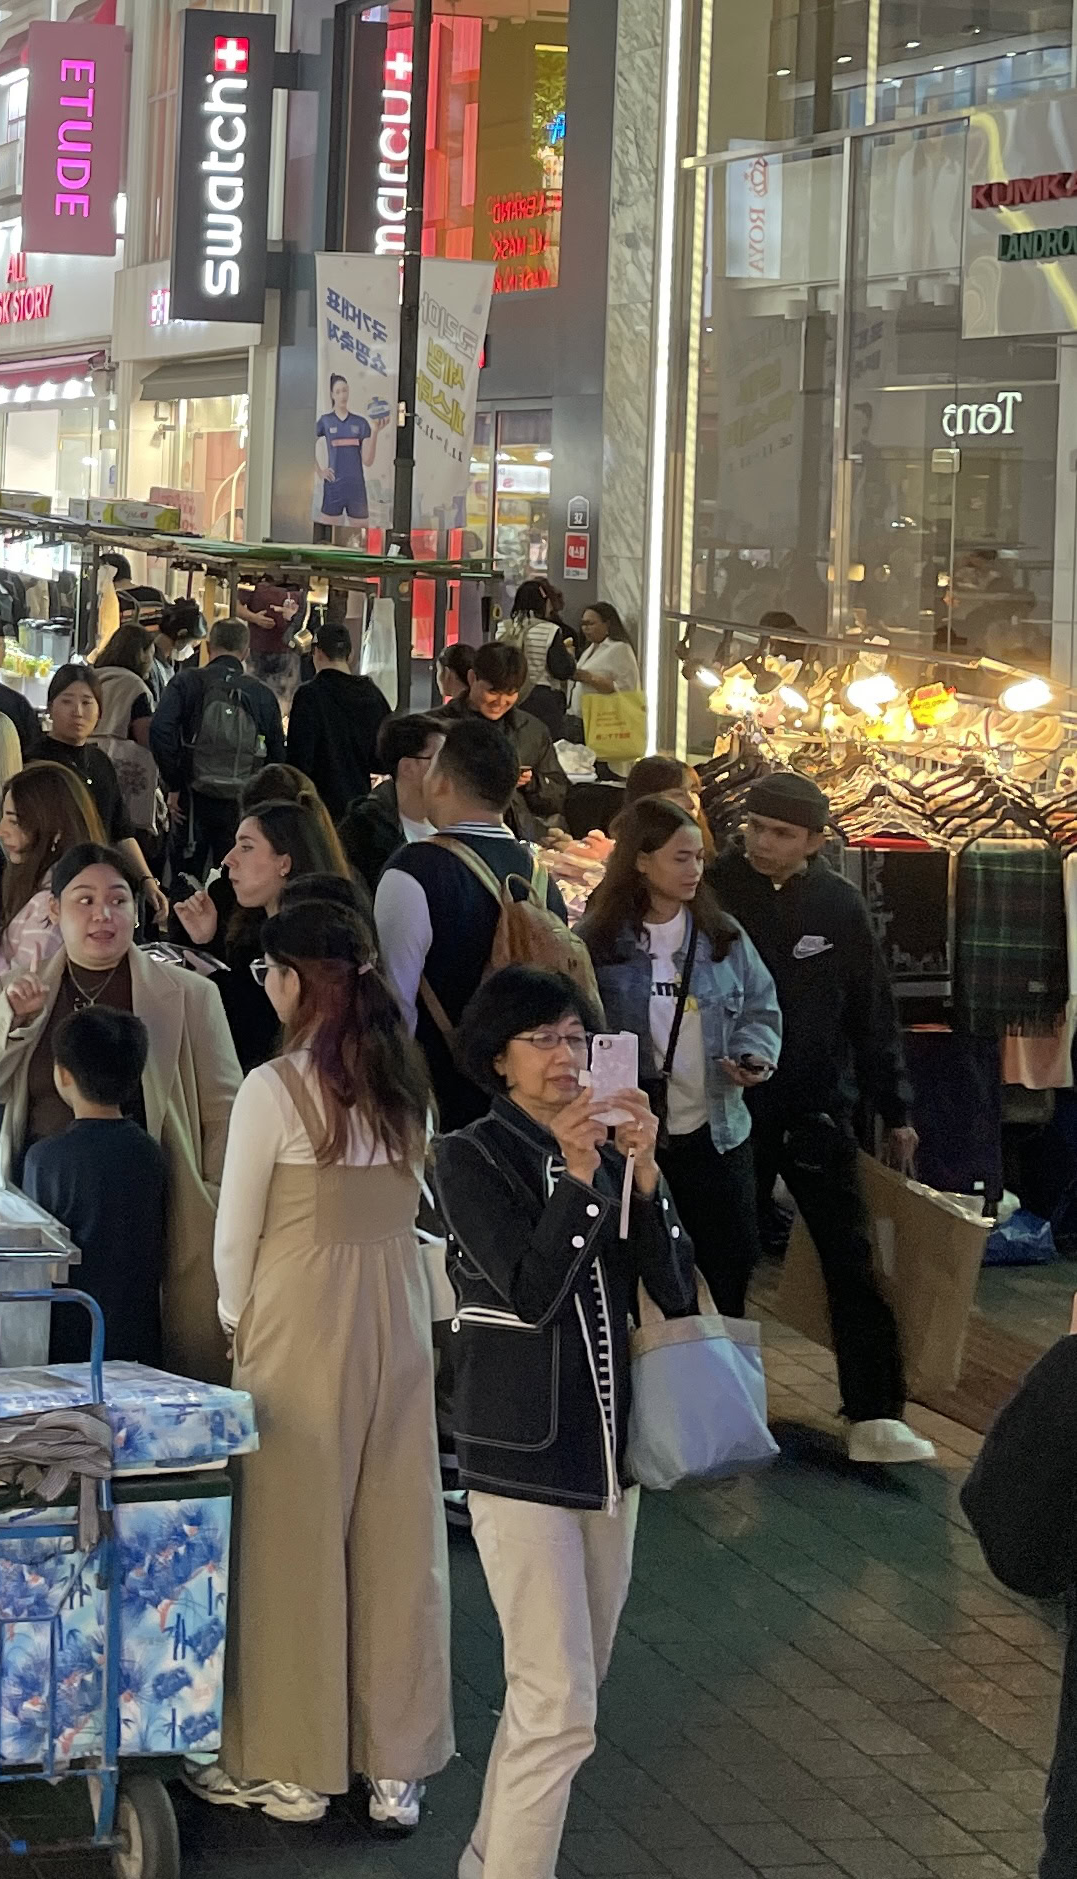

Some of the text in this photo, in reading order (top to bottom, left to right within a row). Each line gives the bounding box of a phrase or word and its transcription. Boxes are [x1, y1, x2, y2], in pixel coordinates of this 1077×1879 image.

[55, 58, 96, 218] ETUDE
[201, 73, 249, 296] swatch
[6, 252, 27, 284] ALL
[12, 283, 54, 323] STORY
